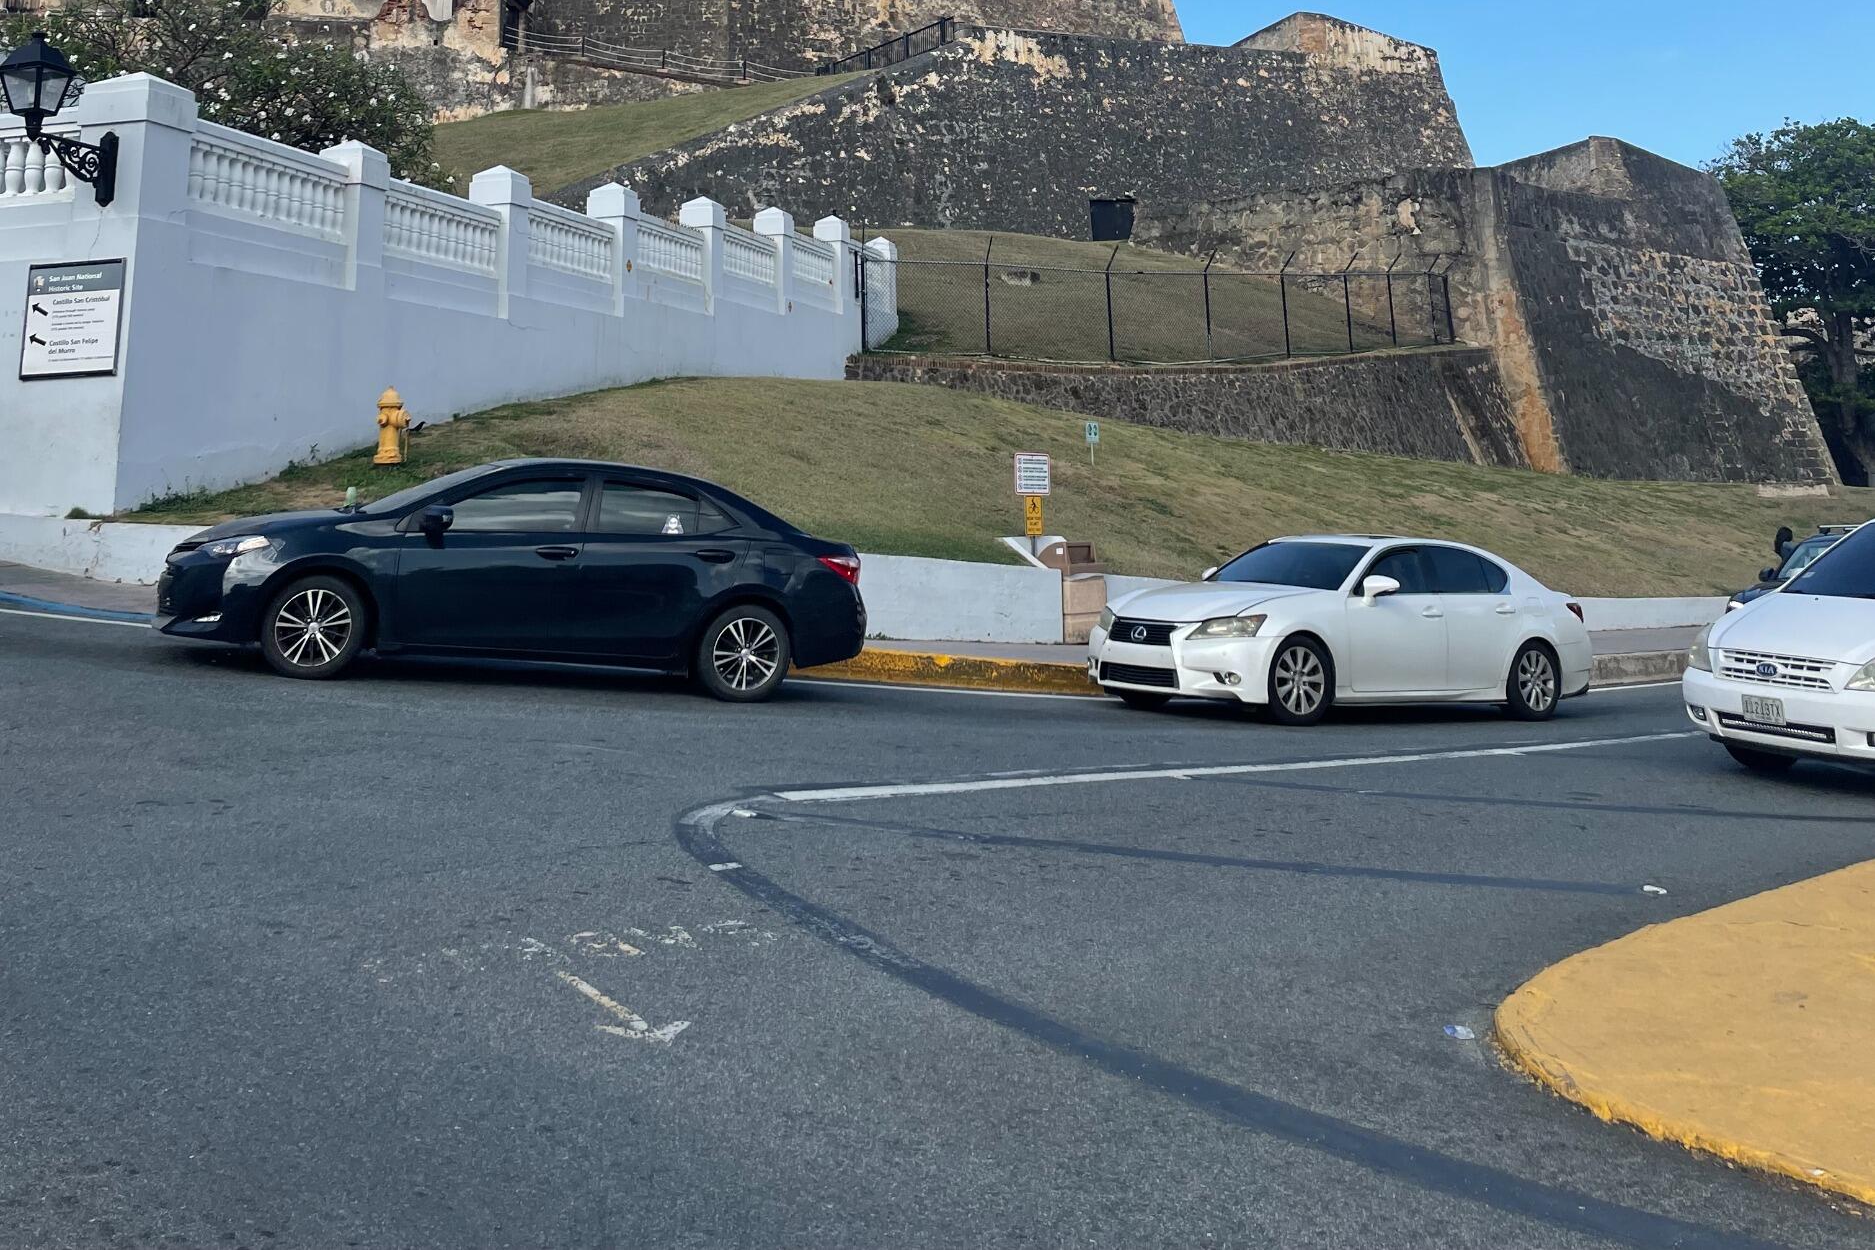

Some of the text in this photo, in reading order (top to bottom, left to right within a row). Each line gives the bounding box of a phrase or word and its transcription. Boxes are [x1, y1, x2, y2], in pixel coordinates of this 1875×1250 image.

[76, 272, 102, 280] National
[82, 337, 99, 345] Felipe
[1758, 665, 1774, 674] KIA
